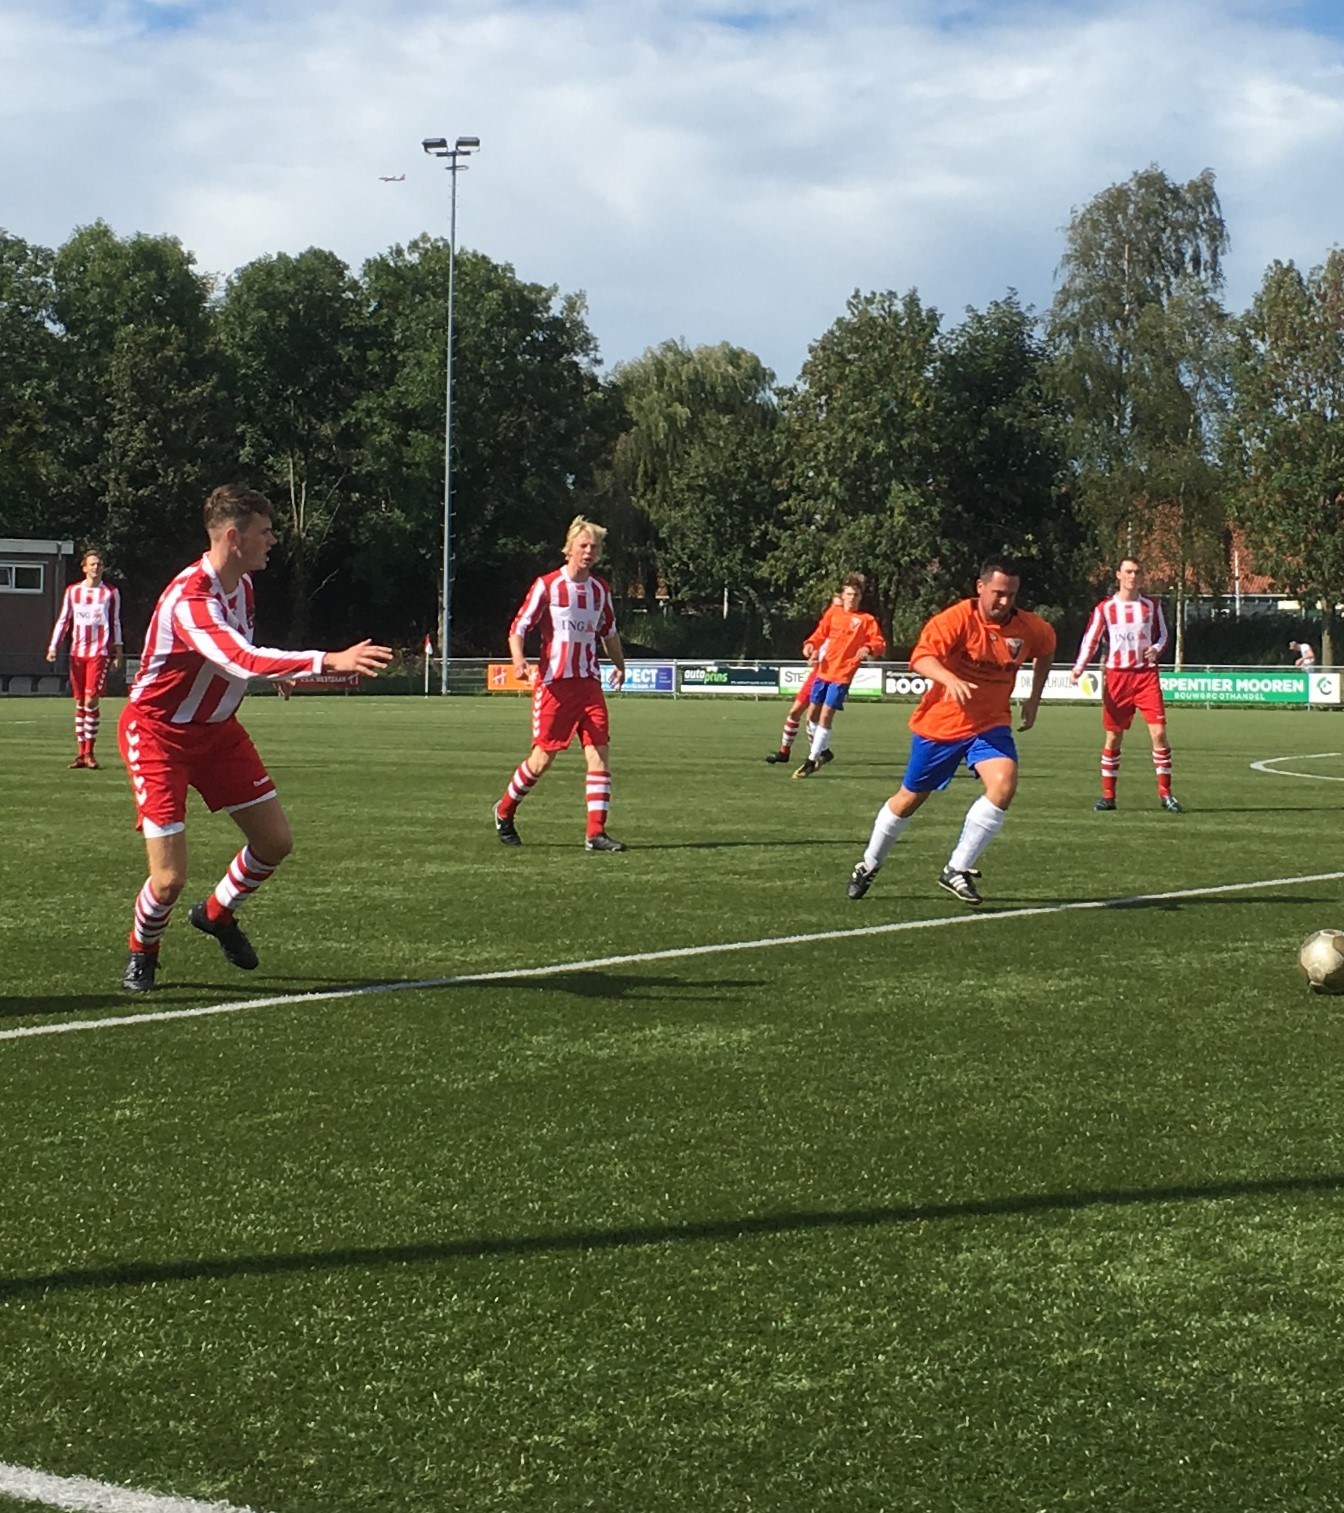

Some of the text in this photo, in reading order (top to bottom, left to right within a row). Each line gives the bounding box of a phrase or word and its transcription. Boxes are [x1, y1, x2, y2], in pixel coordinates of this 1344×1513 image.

[562, 620, 585, 632] ING
[1114, 632, 1135, 642] ING
[600, 668, 658, 684] REPECT
[784, 671, 804, 683] STE
[1159, 678, 1304, 693] RPENTIER MOOREN
